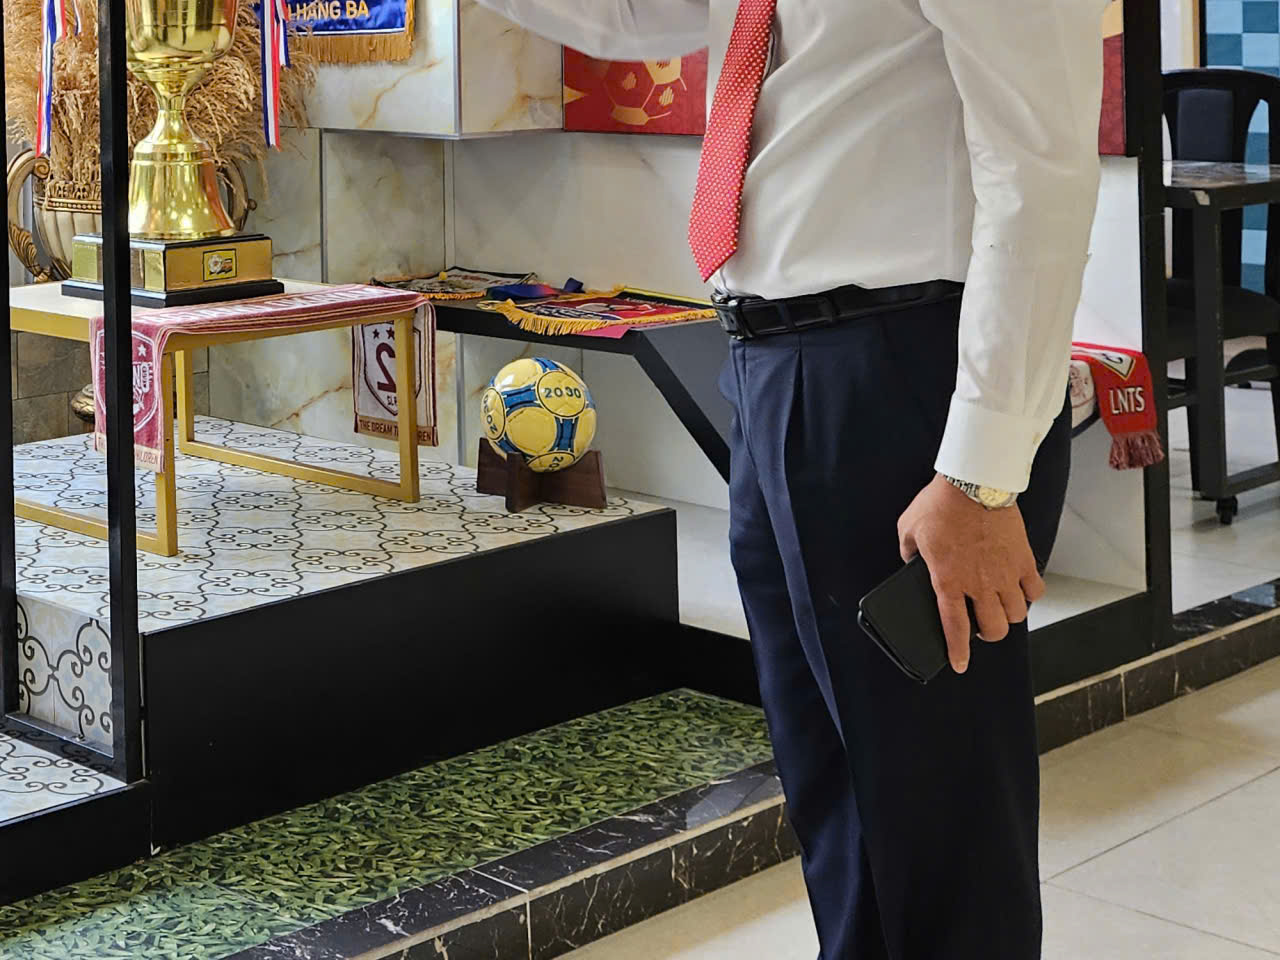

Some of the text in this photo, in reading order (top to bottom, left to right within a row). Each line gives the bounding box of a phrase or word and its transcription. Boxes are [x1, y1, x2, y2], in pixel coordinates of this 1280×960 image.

[345, 0, 369, 20] BA
[543, 386, 582, 398] 2030
[1109, 386, 1146, 415] LNTS
[371, 422, 393, 434] DREAM
